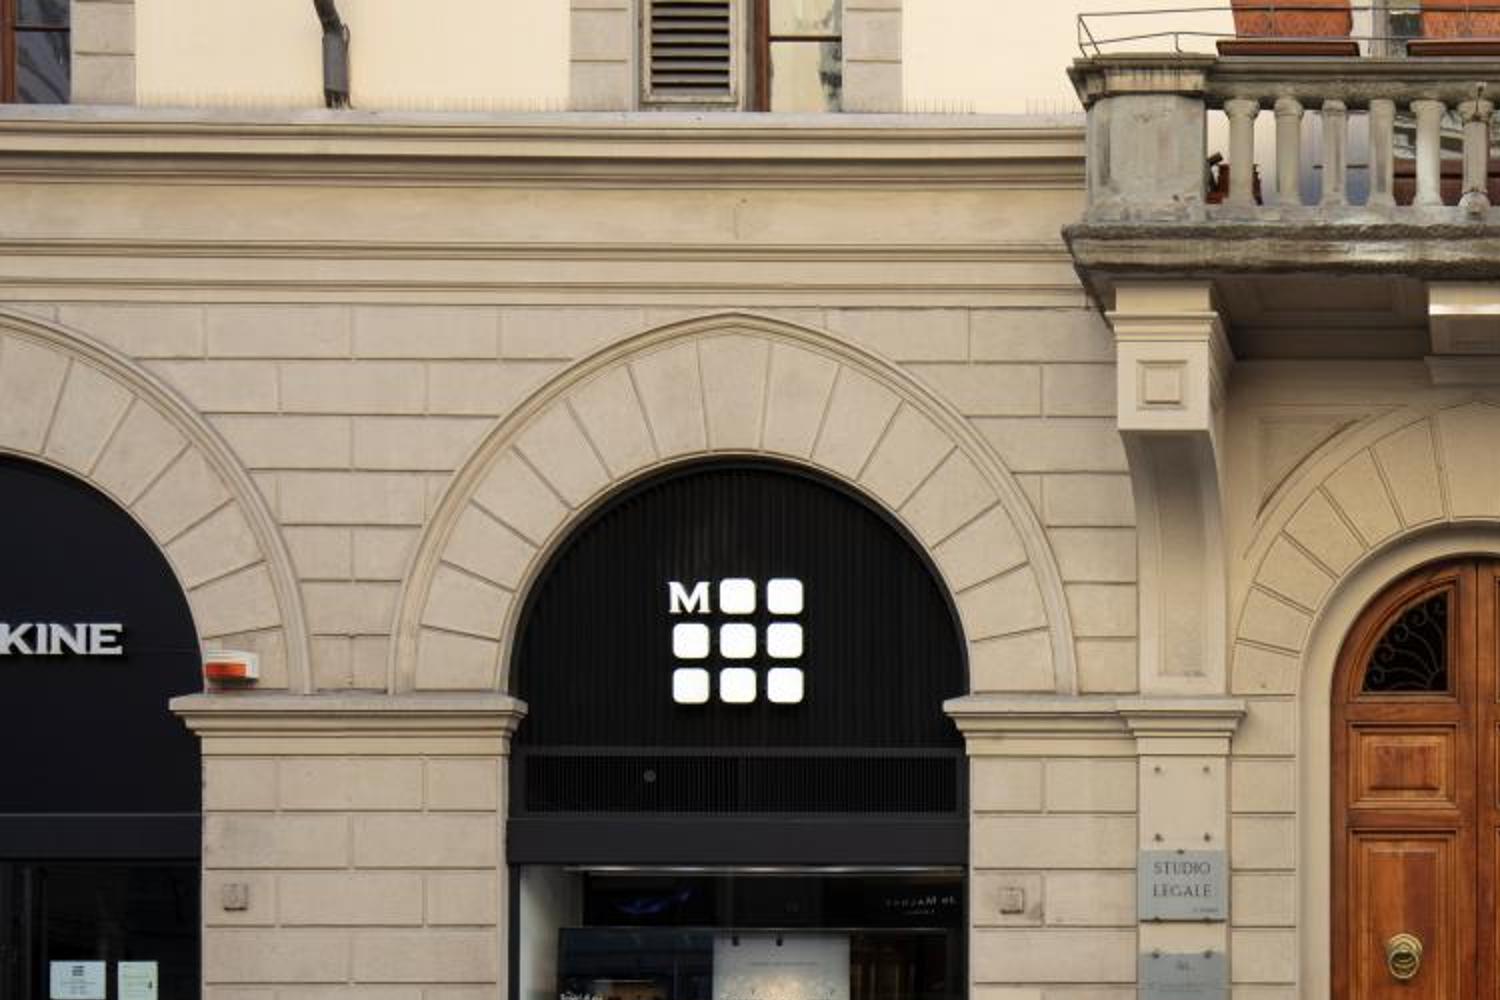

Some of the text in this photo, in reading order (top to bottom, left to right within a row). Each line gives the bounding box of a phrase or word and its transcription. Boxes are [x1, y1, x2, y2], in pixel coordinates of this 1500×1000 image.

[668, 581, 712, 614] M
[0, 622, 123, 655] KINE
[1153, 861, 1212, 875] STUDIO
[1153, 883, 1213, 897] LEGALE
